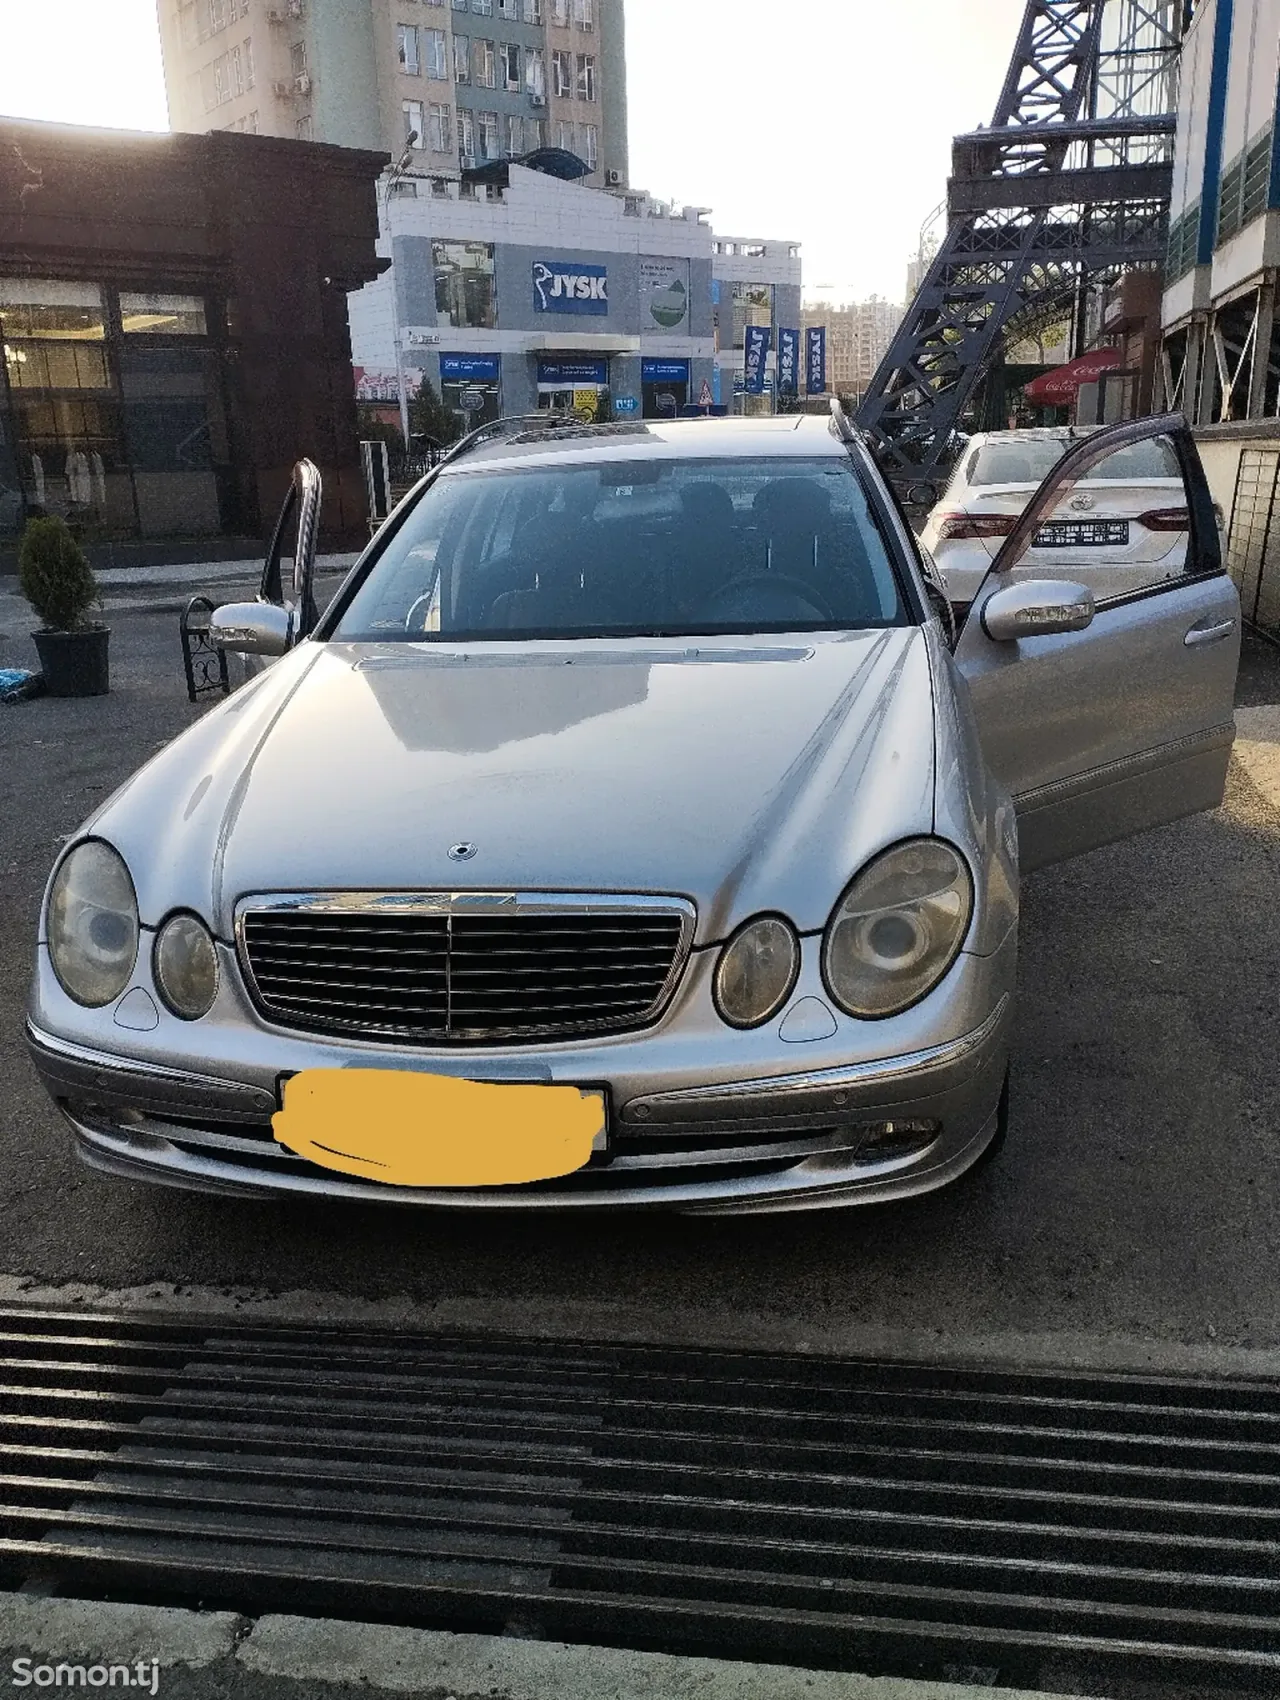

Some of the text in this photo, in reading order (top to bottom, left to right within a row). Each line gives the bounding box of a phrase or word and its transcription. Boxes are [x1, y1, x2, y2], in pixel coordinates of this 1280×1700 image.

[550, 274, 608, 300] JYSK
[746, 329, 763, 381] JYSK
[781, 332, 793, 382] JYSK
[810, 332, 821, 381] JYSK
